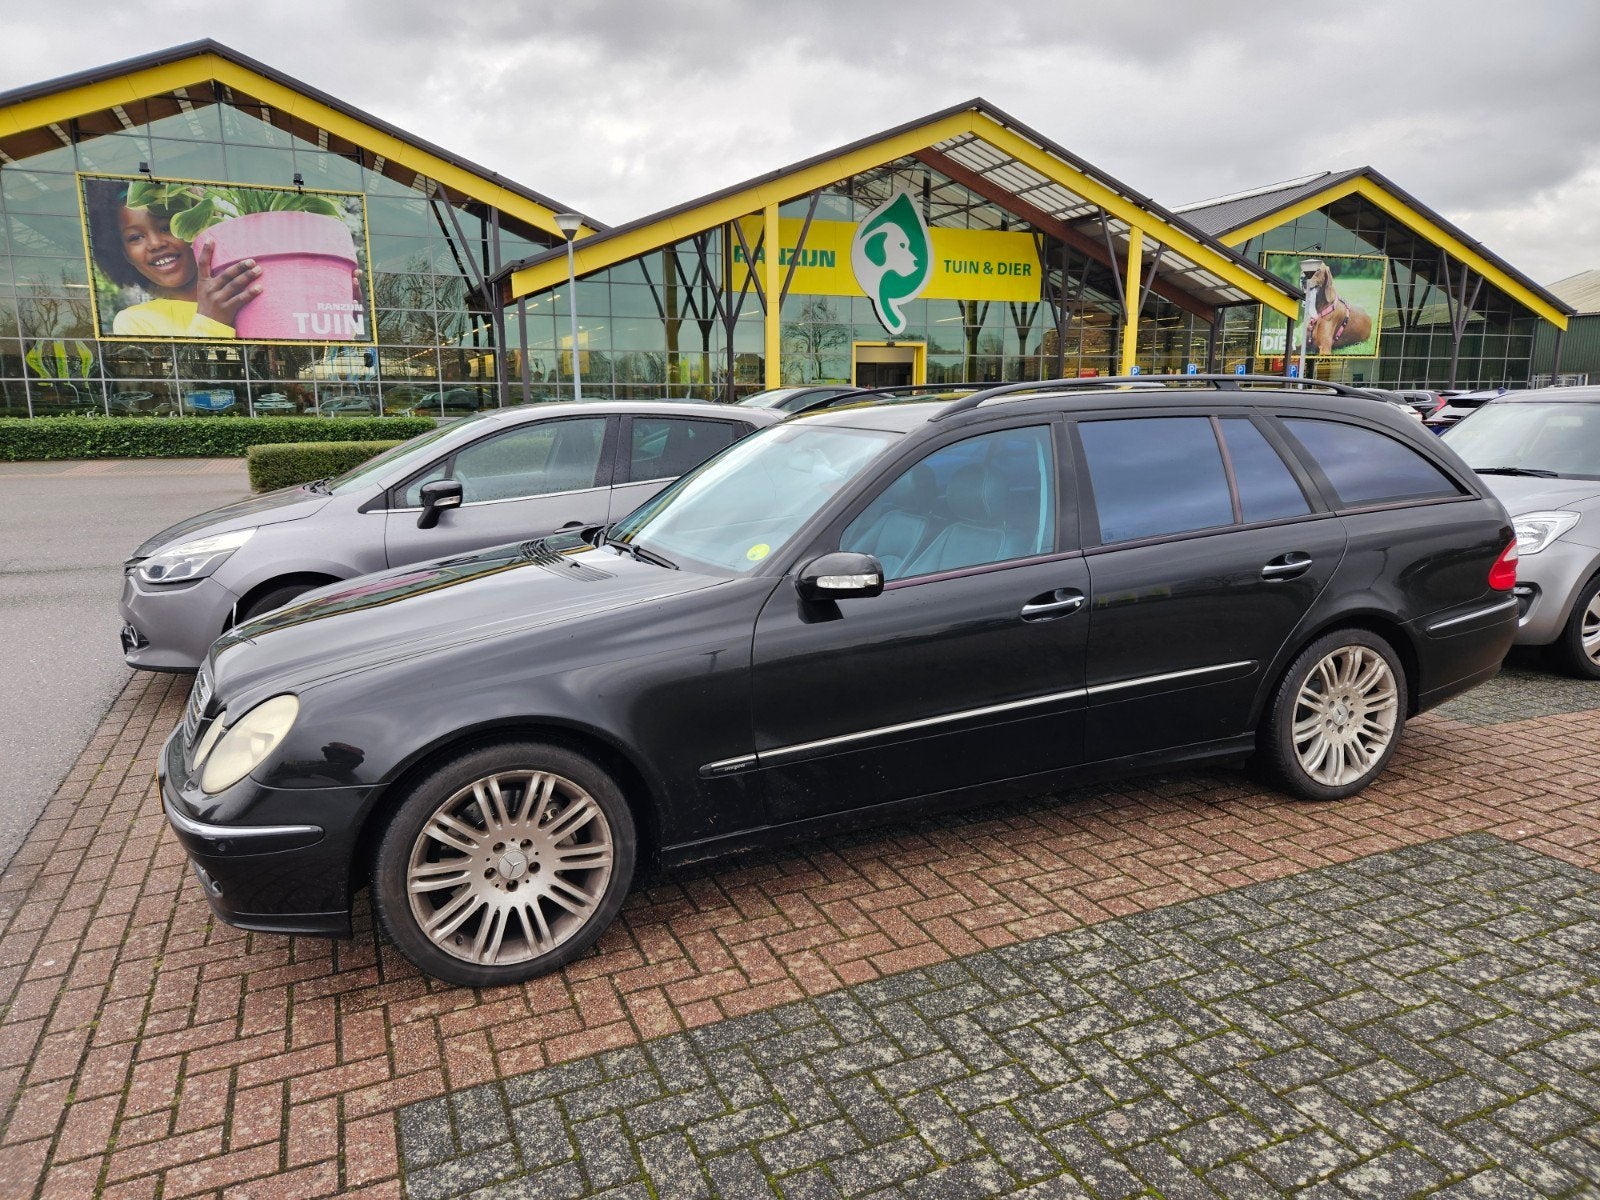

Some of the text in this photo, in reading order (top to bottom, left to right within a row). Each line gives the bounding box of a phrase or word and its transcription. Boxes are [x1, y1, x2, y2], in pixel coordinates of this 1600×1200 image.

[944, 259, 1032, 277] TUIN & DIER
[317, 302, 364, 311] RANZIJN
[292, 312, 366, 335] TUIN
